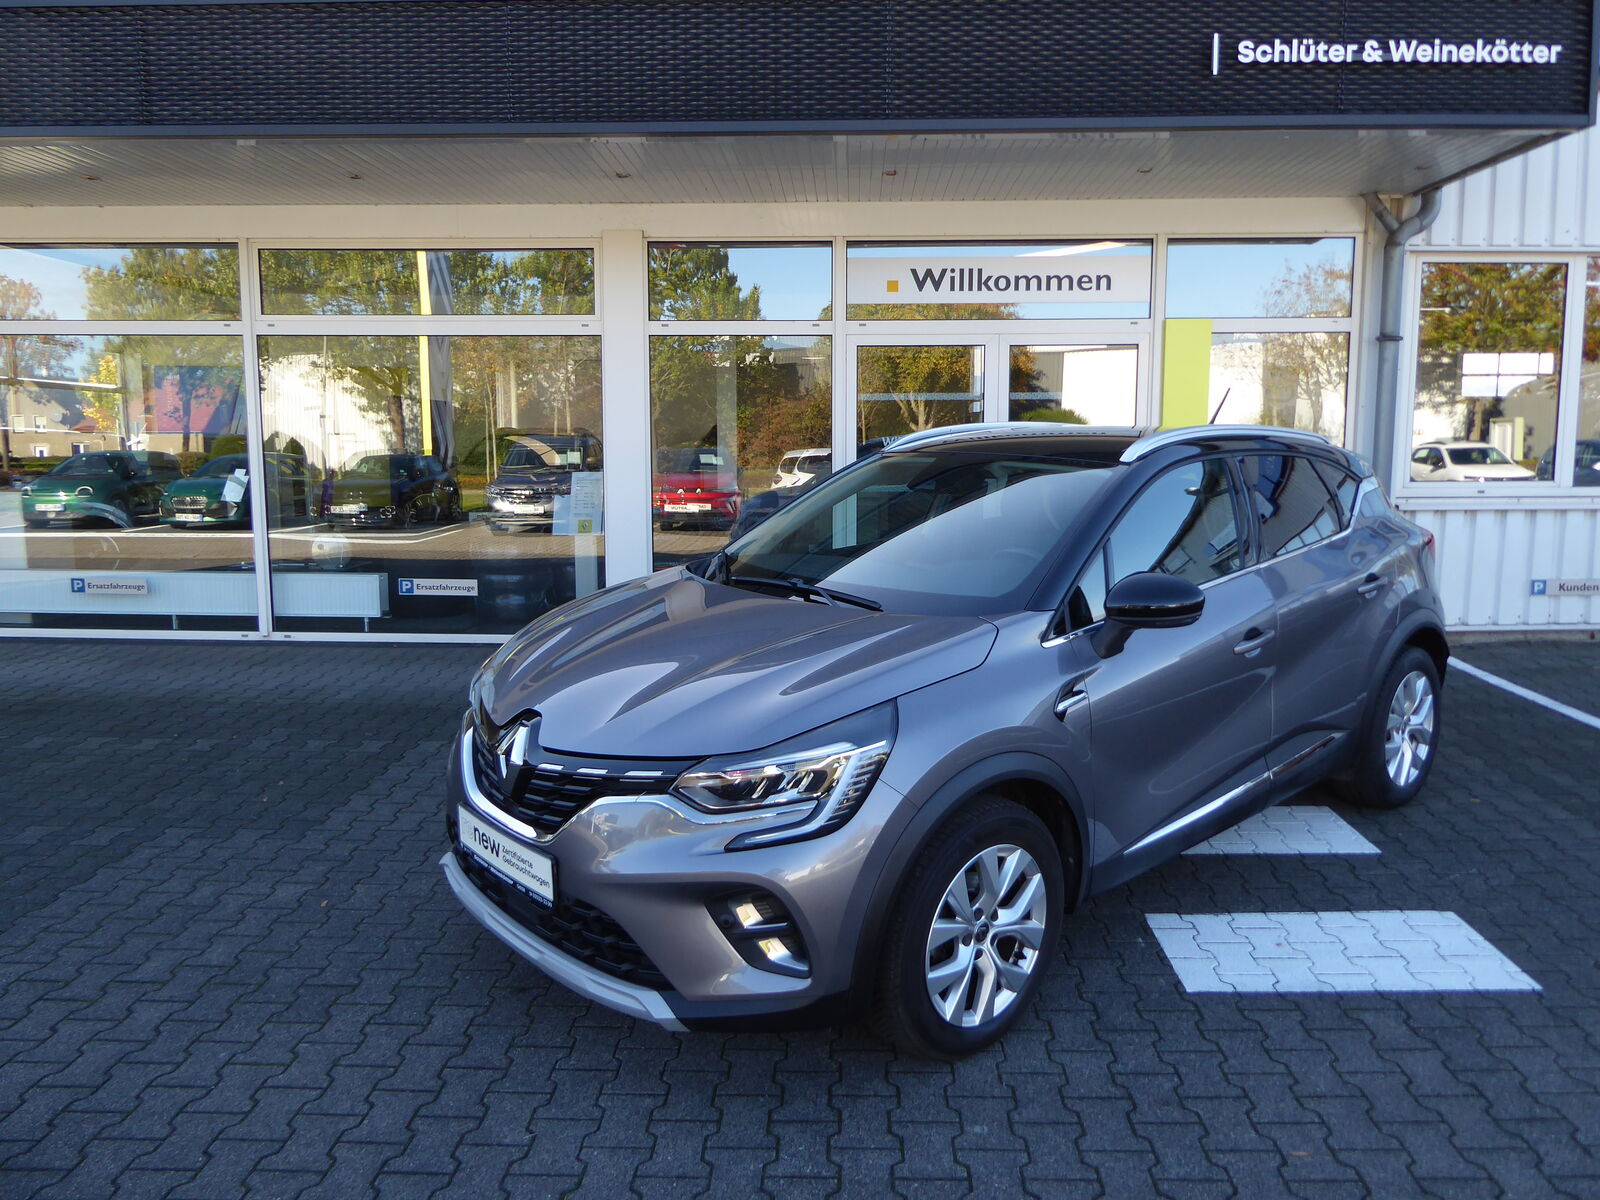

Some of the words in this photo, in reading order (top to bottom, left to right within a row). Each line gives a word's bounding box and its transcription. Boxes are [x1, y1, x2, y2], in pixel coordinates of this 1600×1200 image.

[1237, 39, 1357, 63] Schlüter
[1362, 39, 1382, 63] &
[1389, 39, 1562, 63] Weinekötter
[910, 268, 1112, 292] Willkommen
[73, 580, 83, 591] P
[87, 582, 145, 591] Ersatzfahrzeuge
[402, 581, 411, 592] P
[416, 583, 476, 592] Ersatzfahrzeuge
[1534, 581, 1544, 593] P
[1559, 582, 1599, 592] Kunden
[473, 825, 500, 858] new
